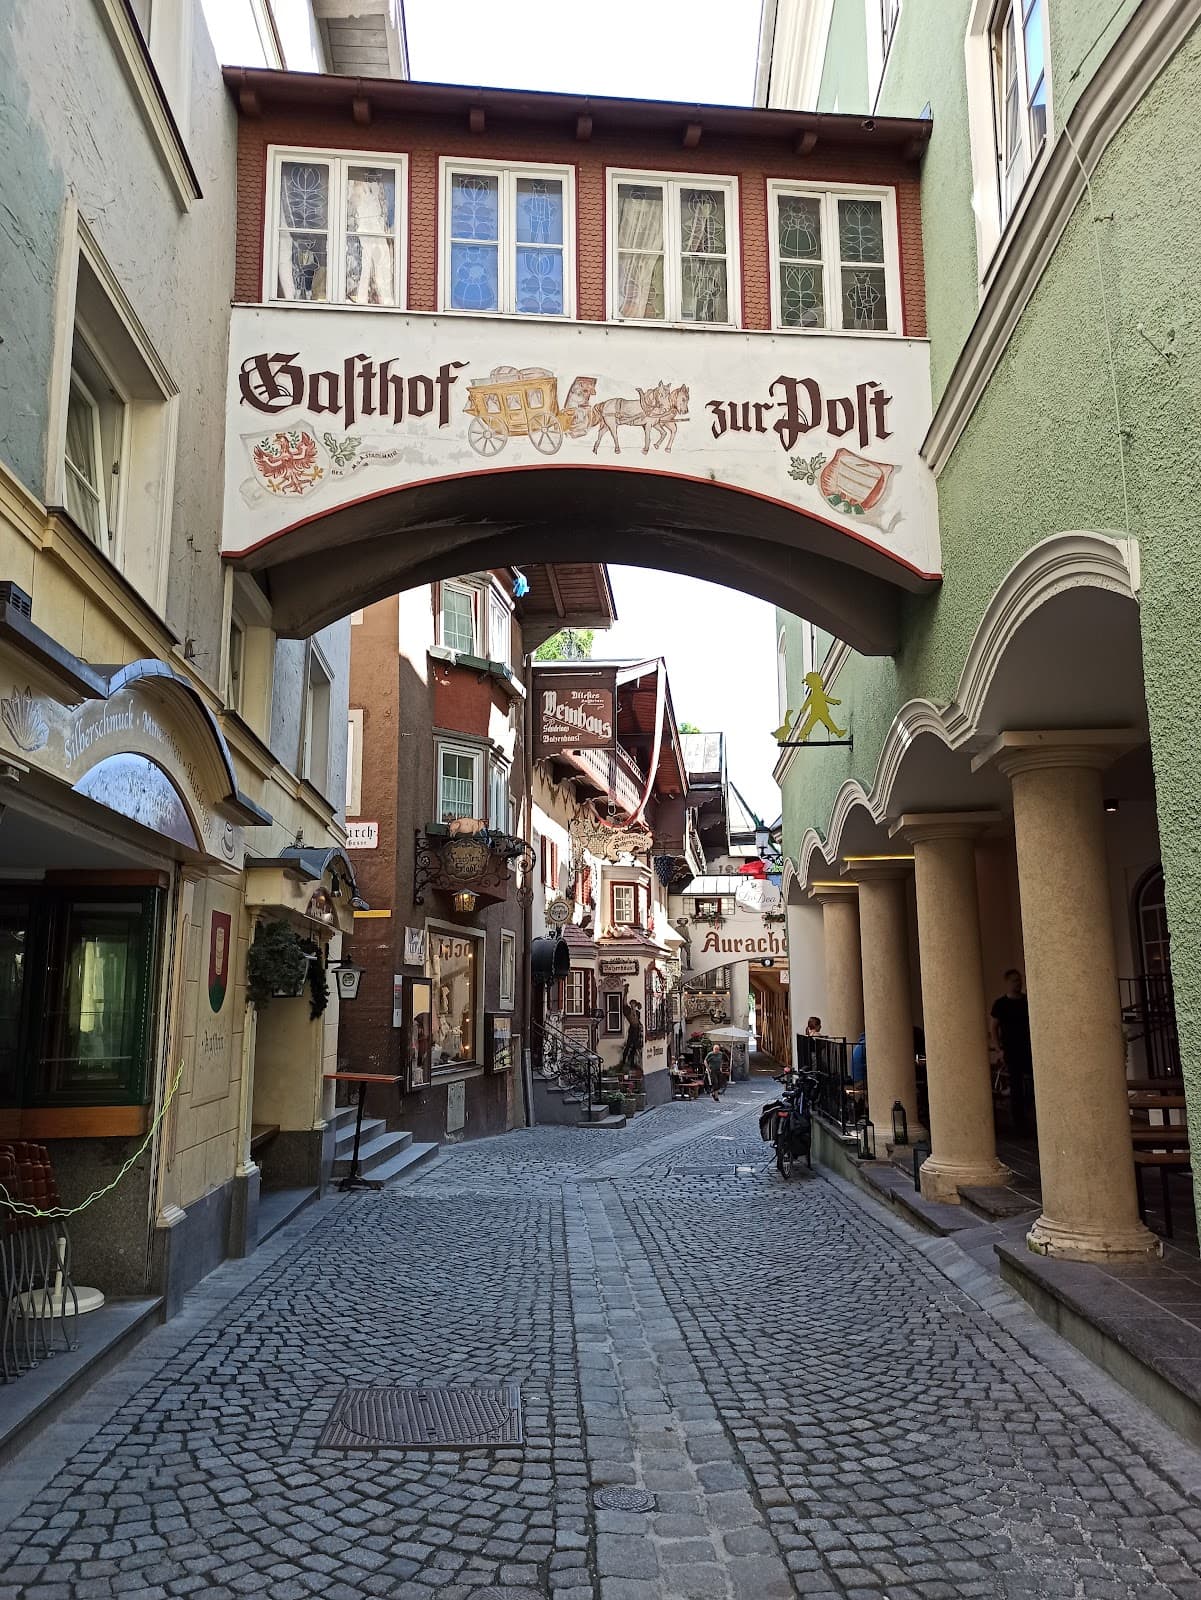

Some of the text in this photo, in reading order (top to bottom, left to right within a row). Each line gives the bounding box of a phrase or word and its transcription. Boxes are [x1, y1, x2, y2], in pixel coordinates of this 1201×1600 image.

[239, 351, 894, 452] Gasthof zur Post
[64, 700, 134, 769] Silberschmuck
[542, 690, 613, 739] Weinhaus
[345, 825, 377, 840] irch-
[700, 931, 788, 954] Aurache
